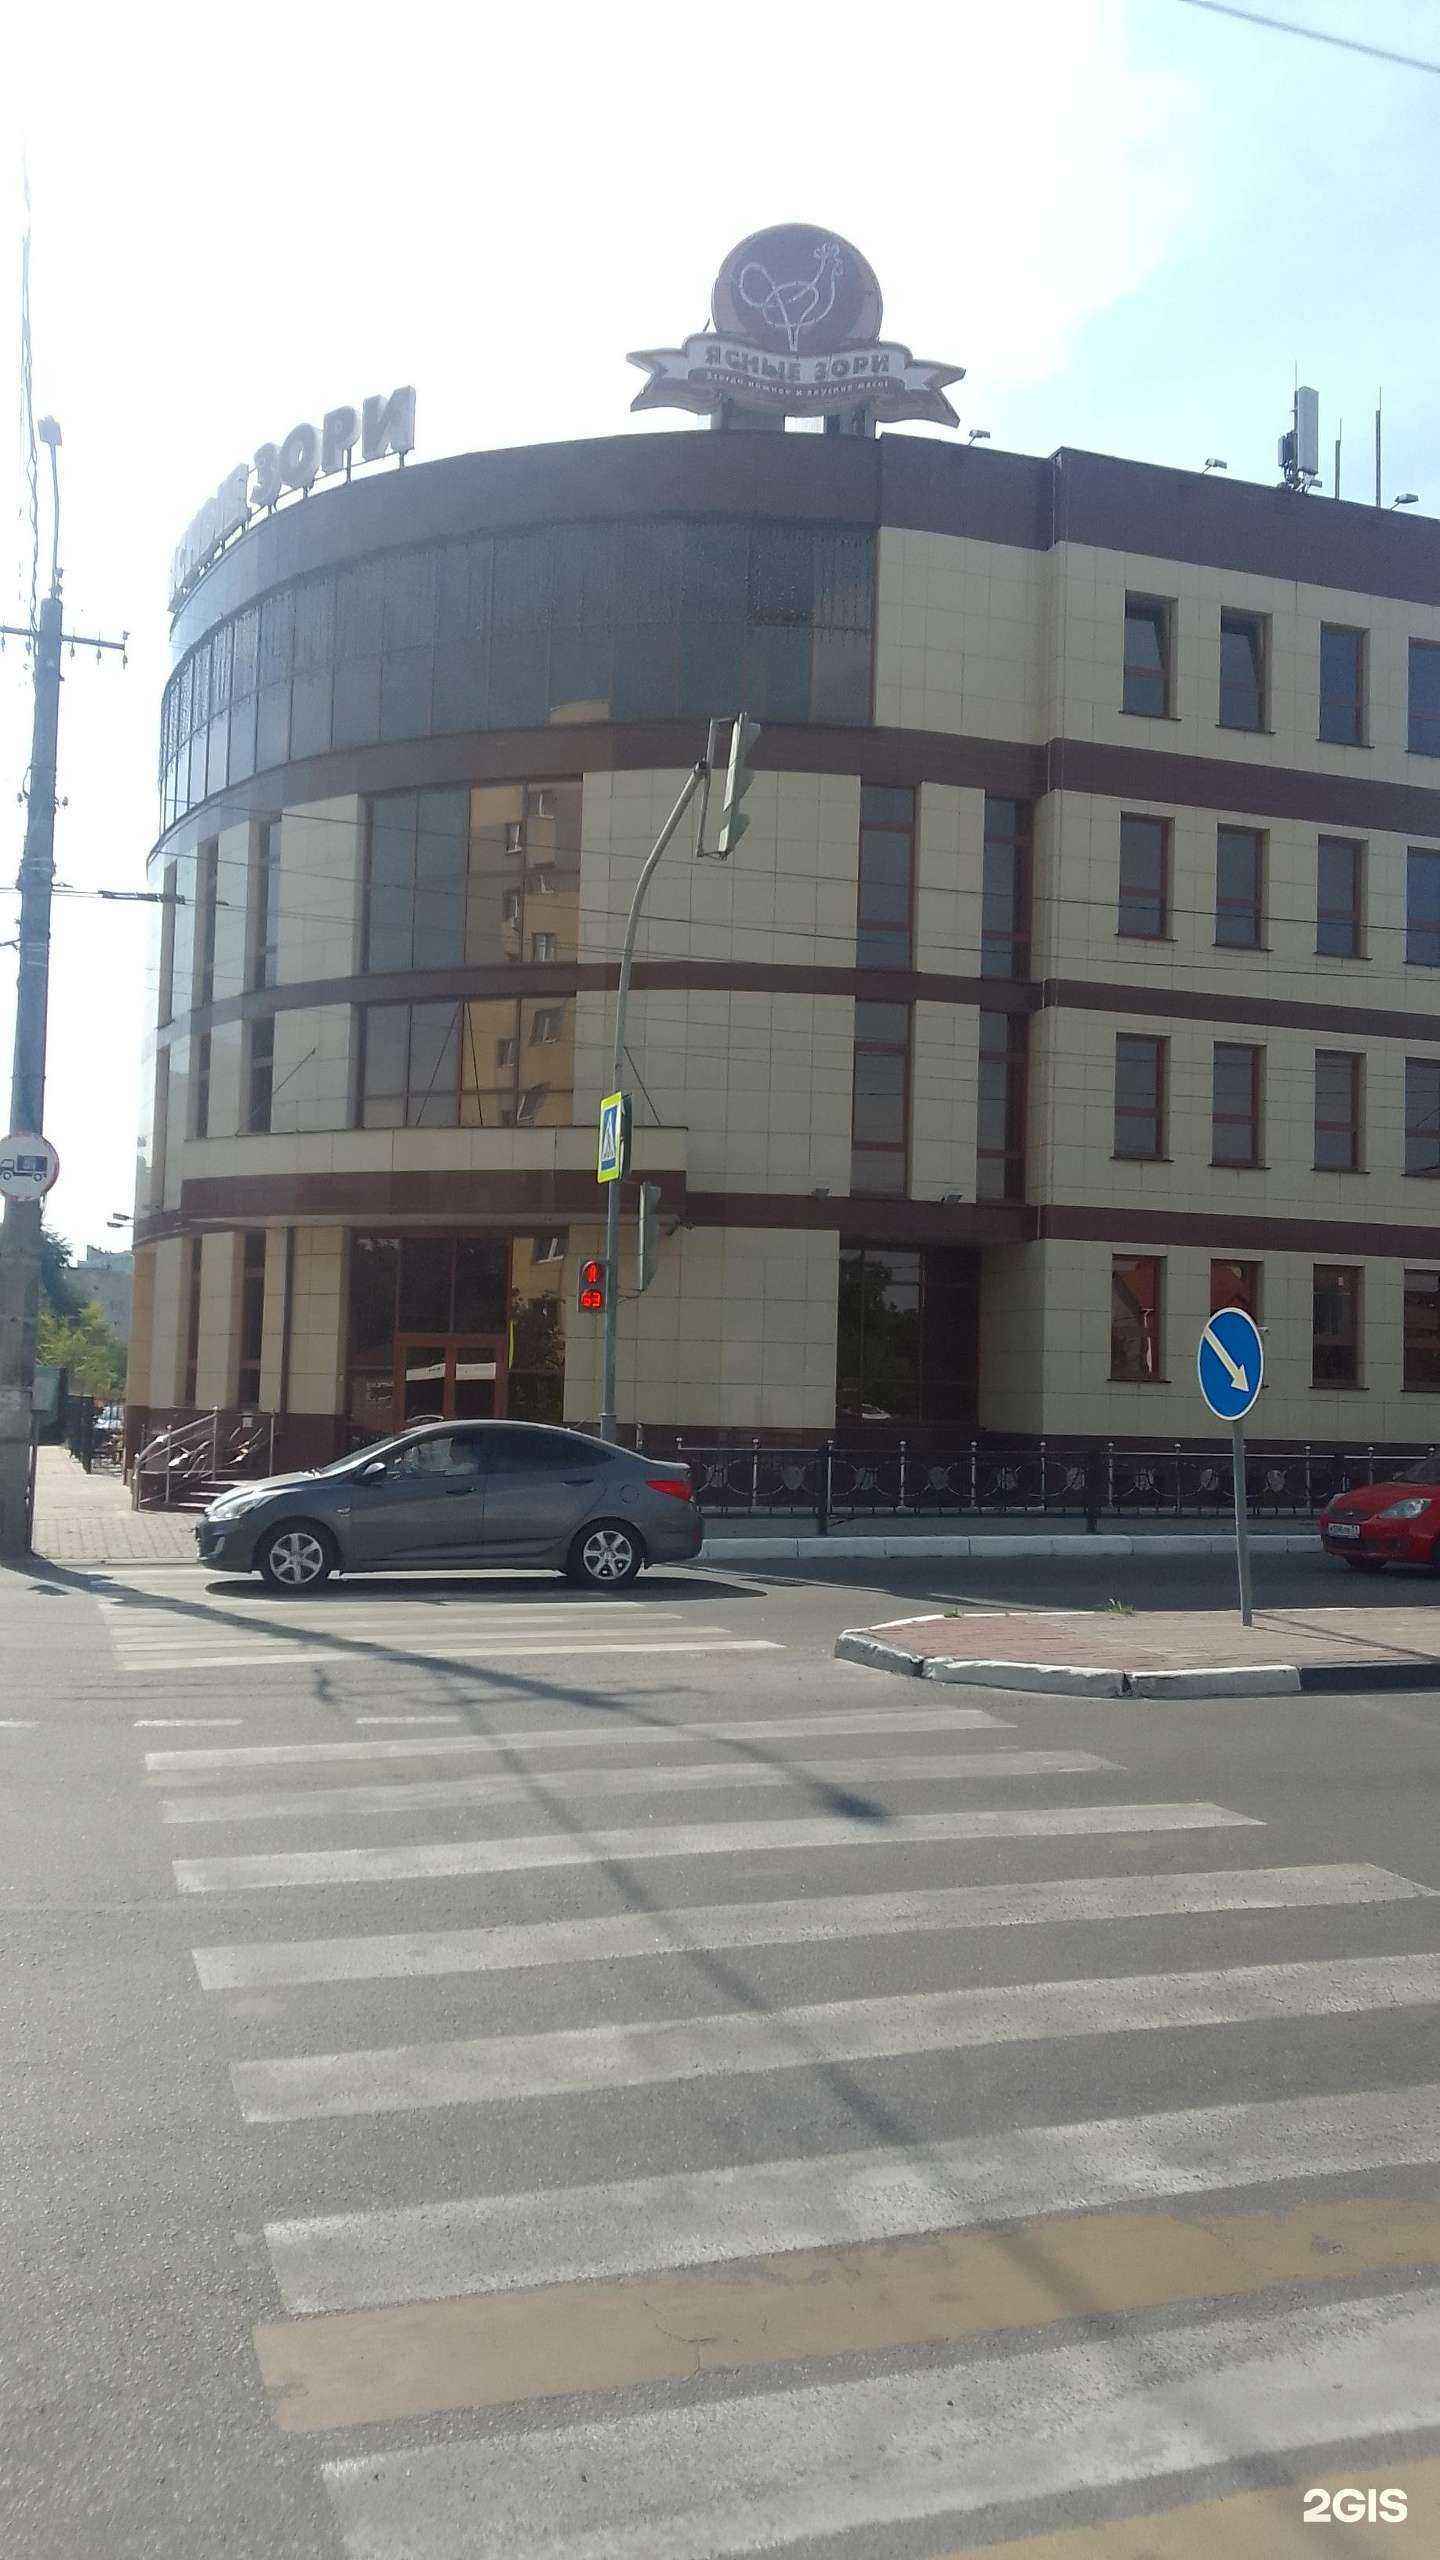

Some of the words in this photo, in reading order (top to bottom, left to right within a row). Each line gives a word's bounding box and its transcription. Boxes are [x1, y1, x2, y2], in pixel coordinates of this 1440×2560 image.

[705, 344, 801, 381] ЯСНЫЕ
[814, 354, 889, 382] ЗОРИ
[250, 385, 417, 506] ЗОРИ
